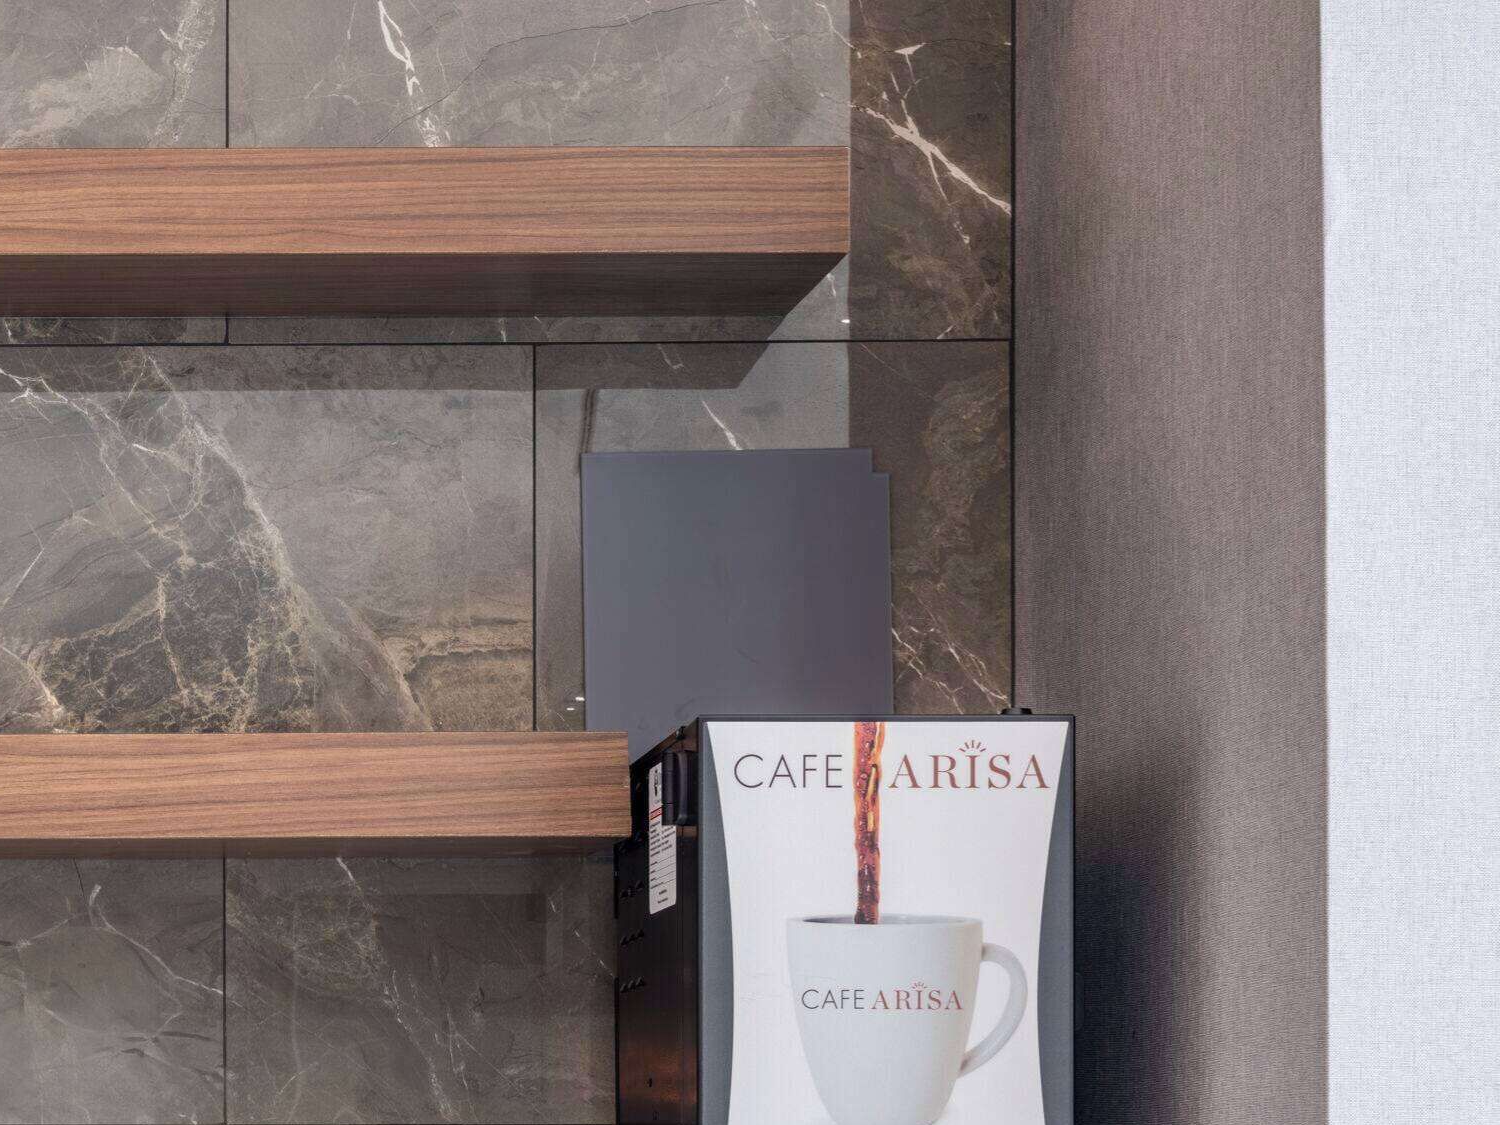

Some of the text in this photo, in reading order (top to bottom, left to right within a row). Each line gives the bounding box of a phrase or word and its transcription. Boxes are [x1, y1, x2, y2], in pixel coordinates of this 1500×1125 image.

[733, 750, 1050, 789] CAFE ARISA
[801, 988, 964, 1011] CAFE ARISA
